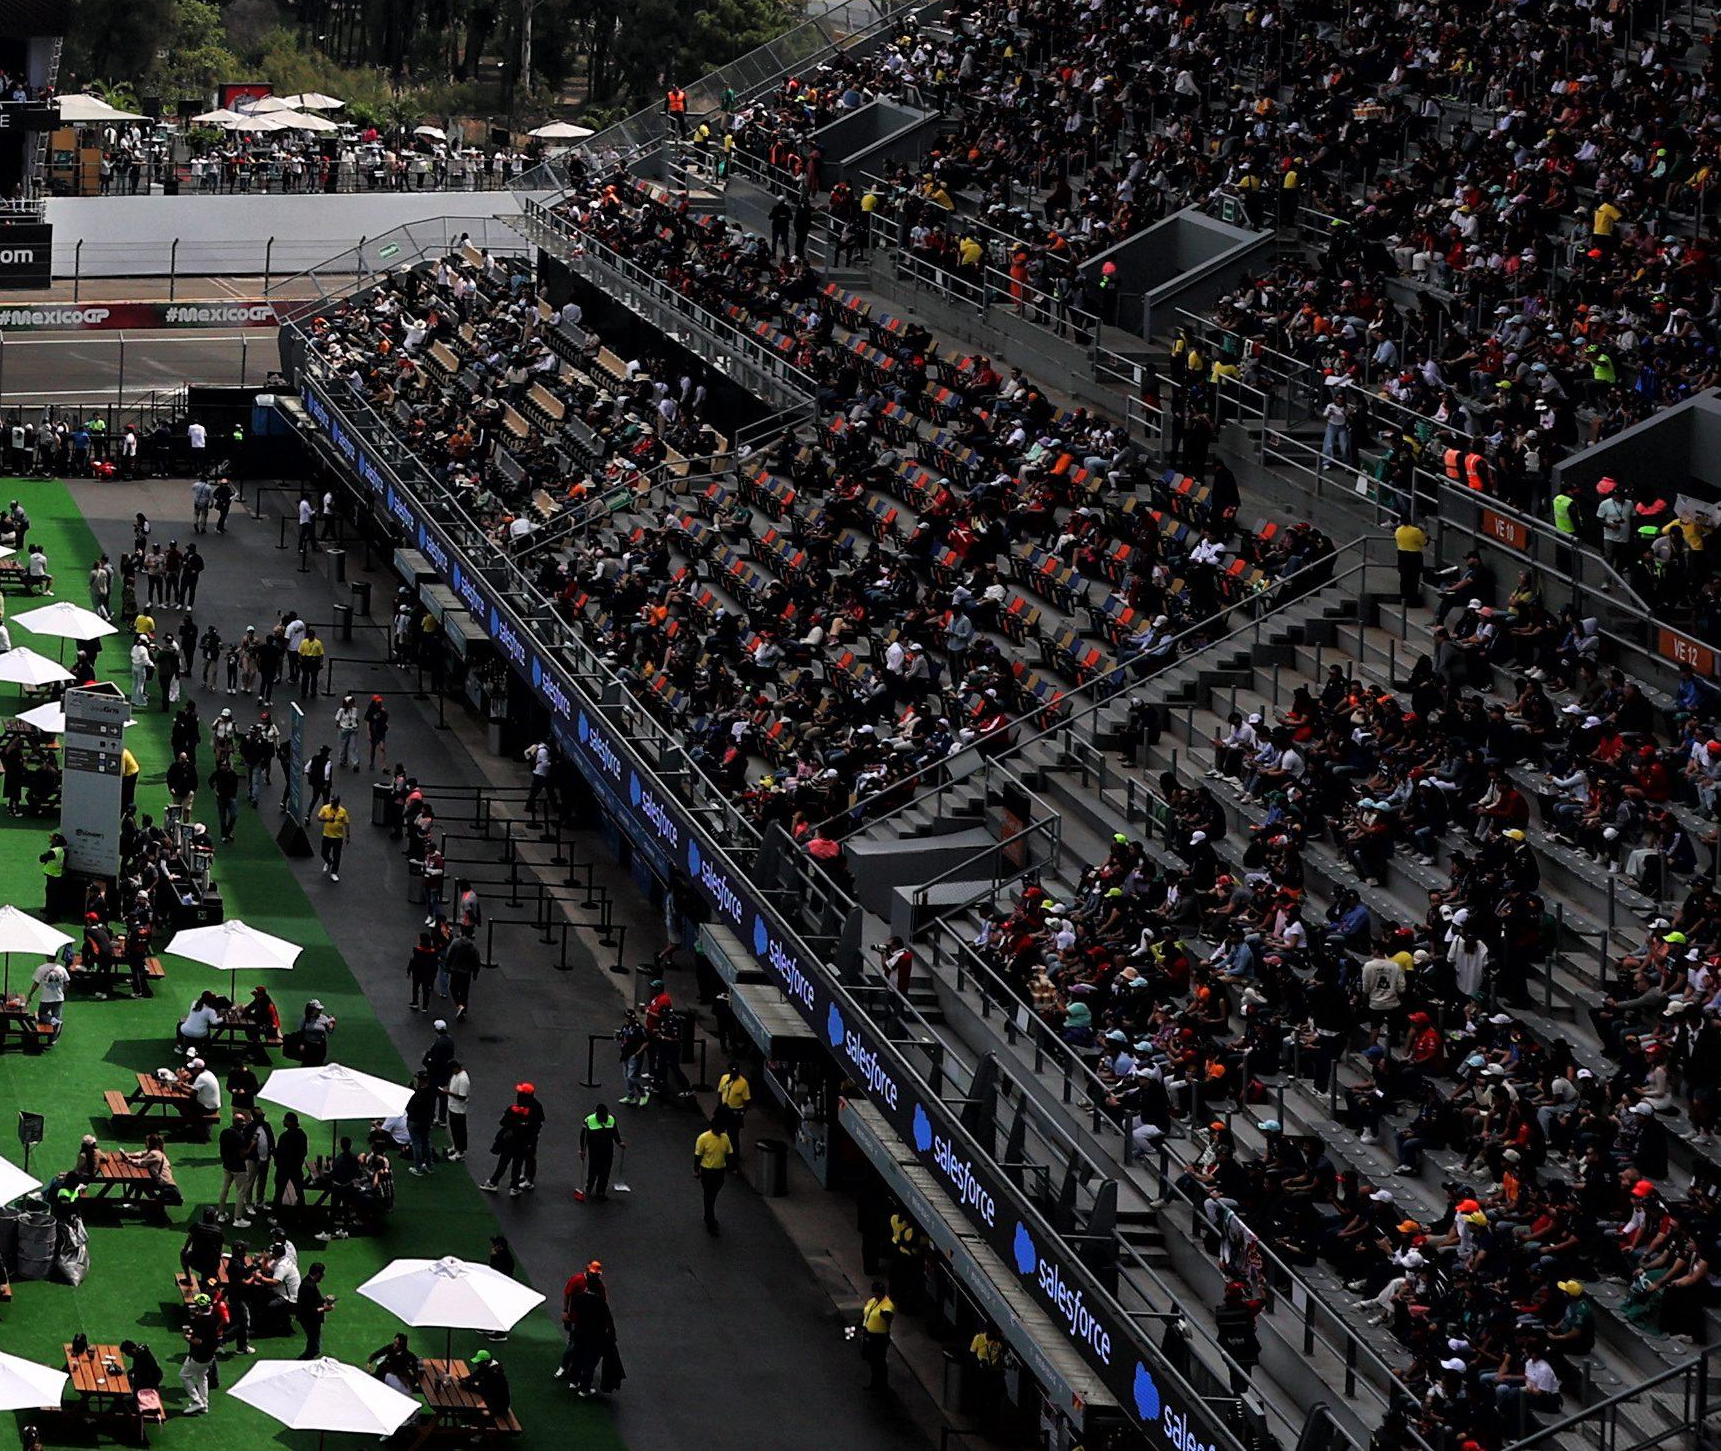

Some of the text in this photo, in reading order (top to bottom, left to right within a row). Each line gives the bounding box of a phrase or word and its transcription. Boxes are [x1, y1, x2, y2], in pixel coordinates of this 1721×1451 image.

[166, 306, 274, 323] #MexicoGP
[1494, 518, 1514, 541] VE 10
[499, 621, 526, 667] salesforce
[1673, 638, 1700, 666] VE 12
[542, 671, 572, 721] salesforce
[589, 727, 621, 782] salesforce
[641, 790, 678, 850] salesforce
[701, 859, 742, 925] salesforce
[768, 937, 815, 1012] salesforce
[845, 1027, 897, 1111] salesforce
[933, 1133, 996, 1230] salesforce
[1038, 1258, 1111, 1366] salesforce
